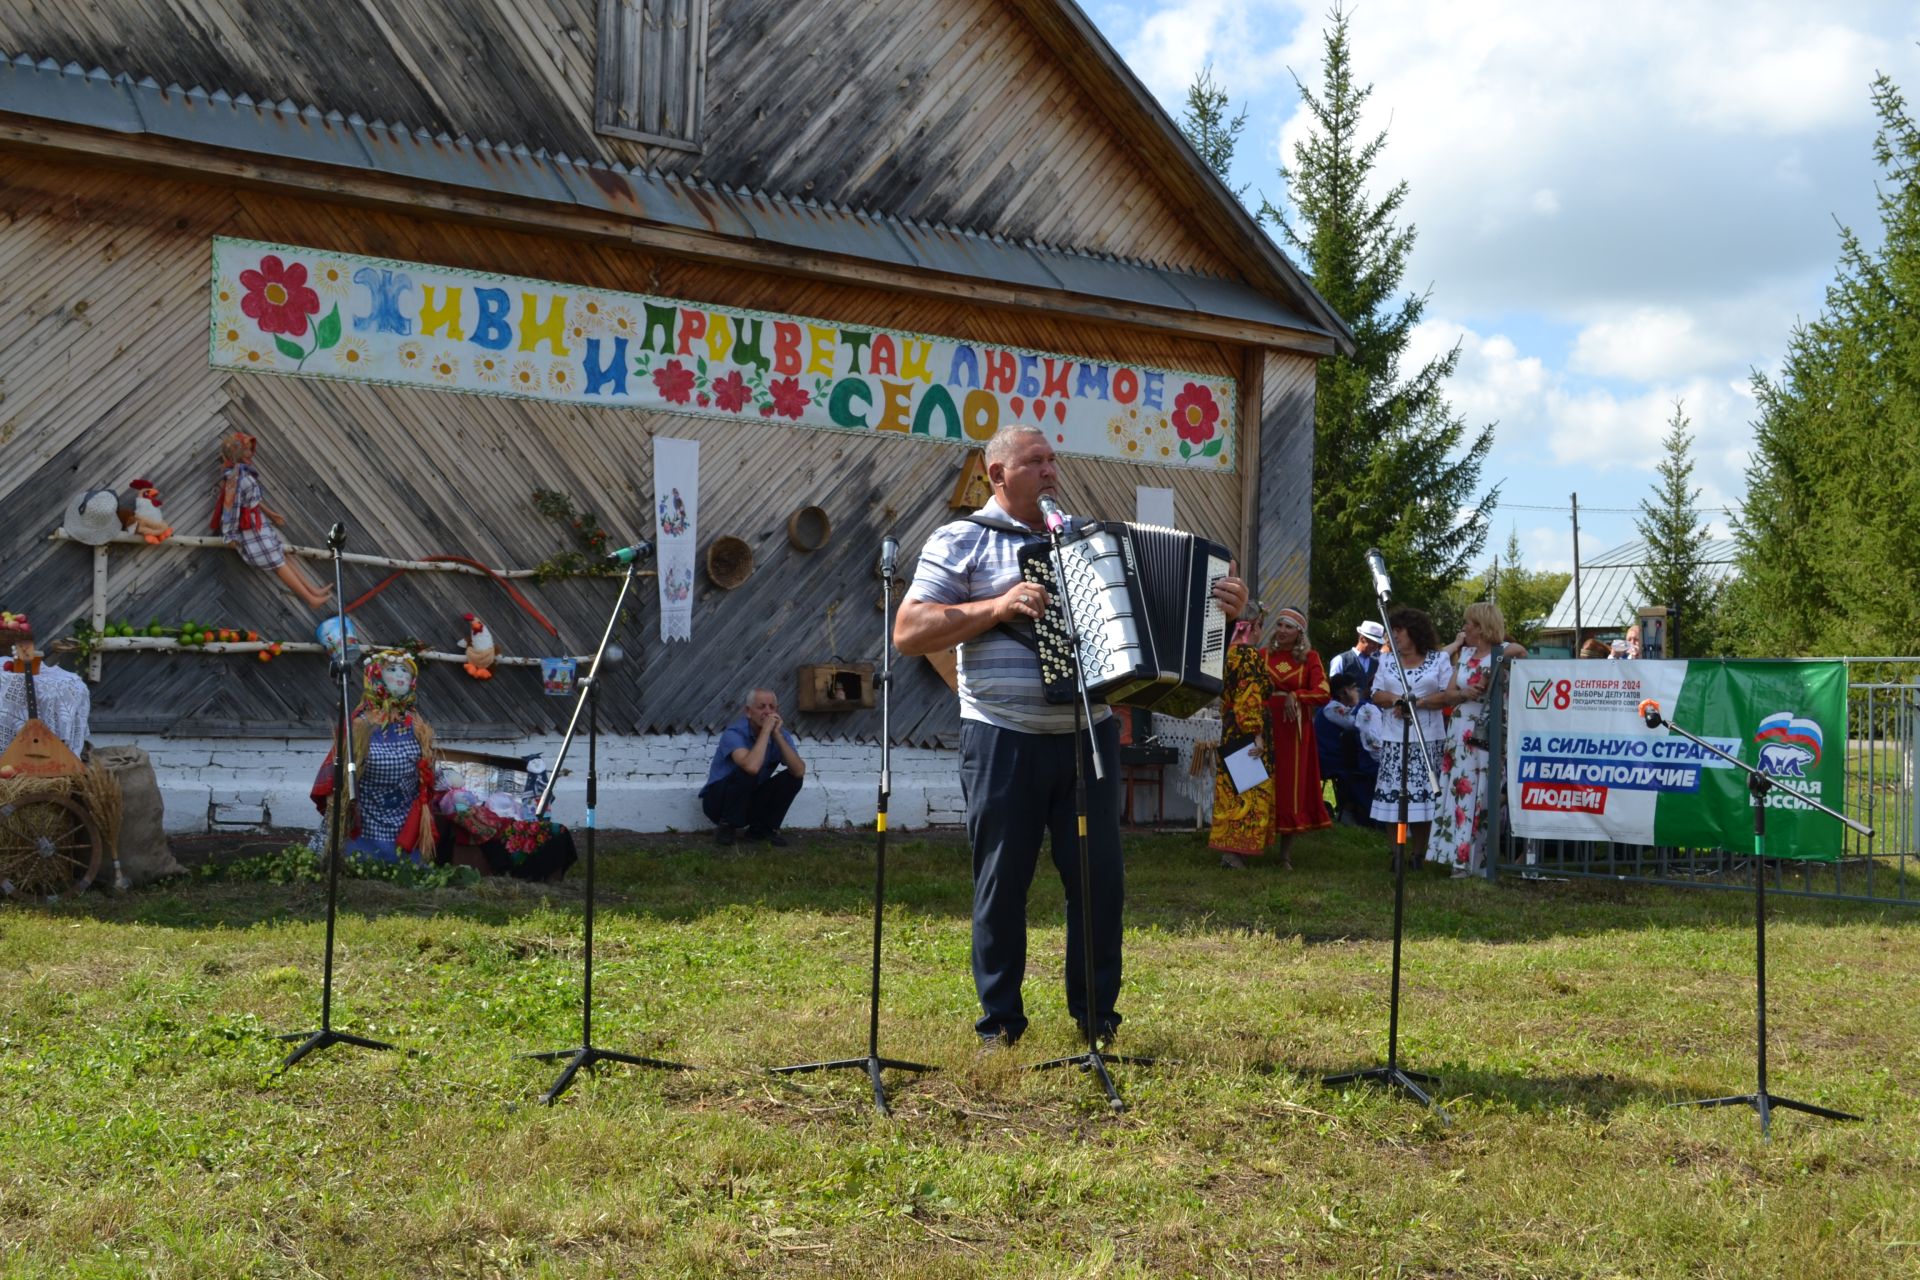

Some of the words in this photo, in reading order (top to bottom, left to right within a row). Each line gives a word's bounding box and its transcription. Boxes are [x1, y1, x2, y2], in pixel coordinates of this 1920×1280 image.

[352, 267, 571, 357] ЖИВИ
[582, 336, 629, 396] И
[639, 302, 933, 384] ПРОЦВЕТАЙ
[947, 344, 1165, 411] ЛЮБИМОЕ
[1553, 680, 1571, 710] 8
[1574, 680, 1619, 690] СЕНТЯБРЯ
[1621, 680, 1641, 690] 2024
[1573, 690, 1604, 699] ВЫБОРЫ
[1604, 690, 1641, 700] ДЕПУТАТОВ
[1521, 736, 1542, 752] ЗА
[1547, 738, 1647, 757] СИЛЬНУЮ
[1521, 762, 1535, 778] И
[1540, 763, 1697, 787] БЛАГОПОЛУЧИЕ
[1525, 788, 1602, 808] ЛЮДЕЙ!
